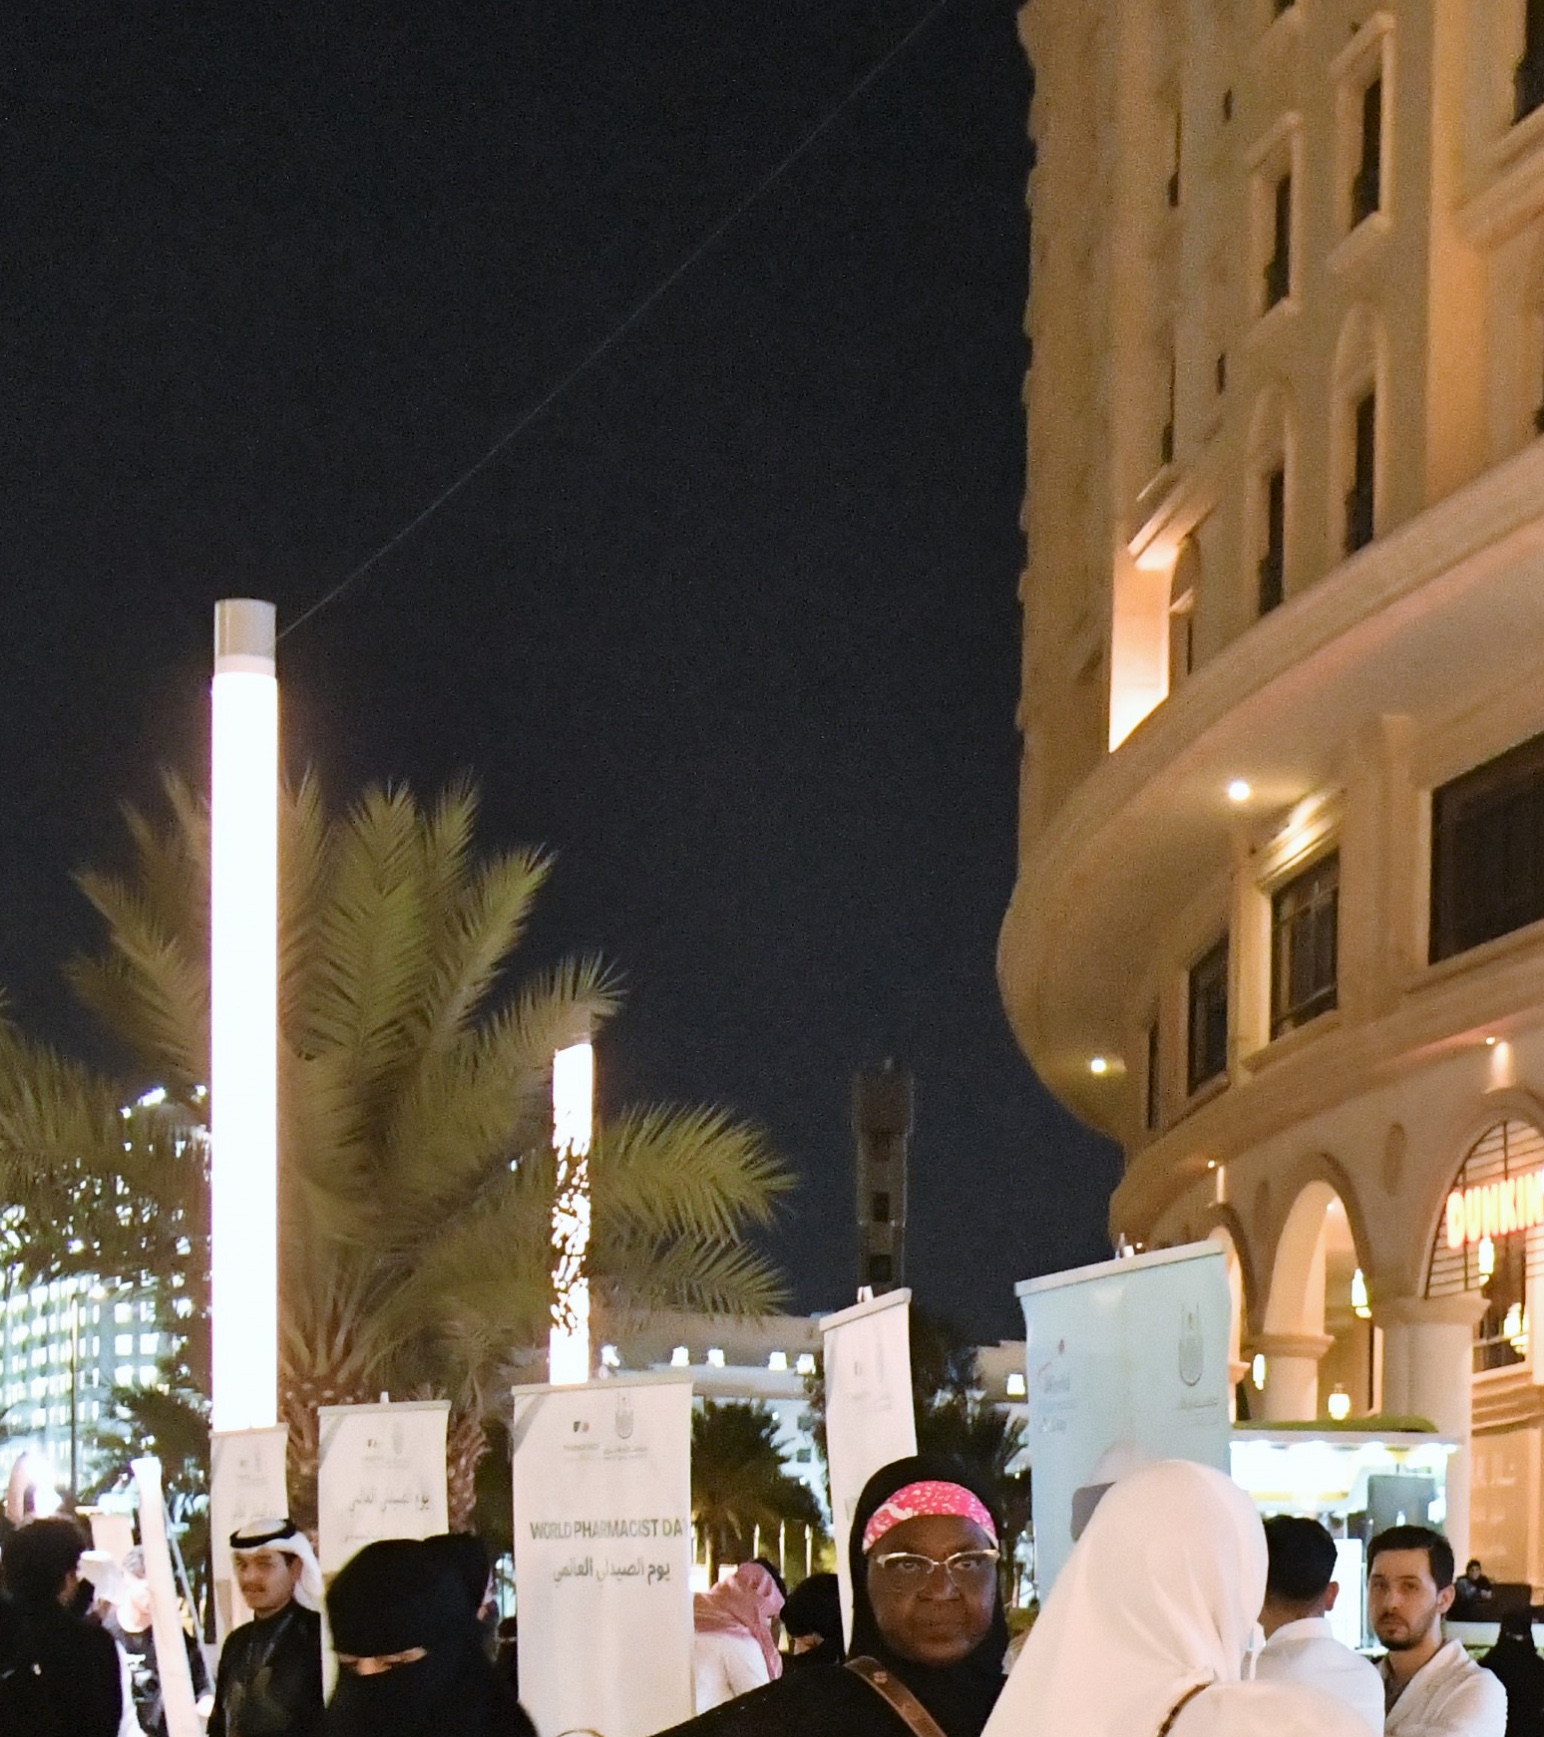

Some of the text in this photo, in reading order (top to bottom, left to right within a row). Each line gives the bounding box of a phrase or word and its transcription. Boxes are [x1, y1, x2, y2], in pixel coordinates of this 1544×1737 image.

[530, 1521, 572, 1540] WORLD
[574, 1518, 658, 1539] PHARMACIST
[647, 1563, 670, 1585] يوم
